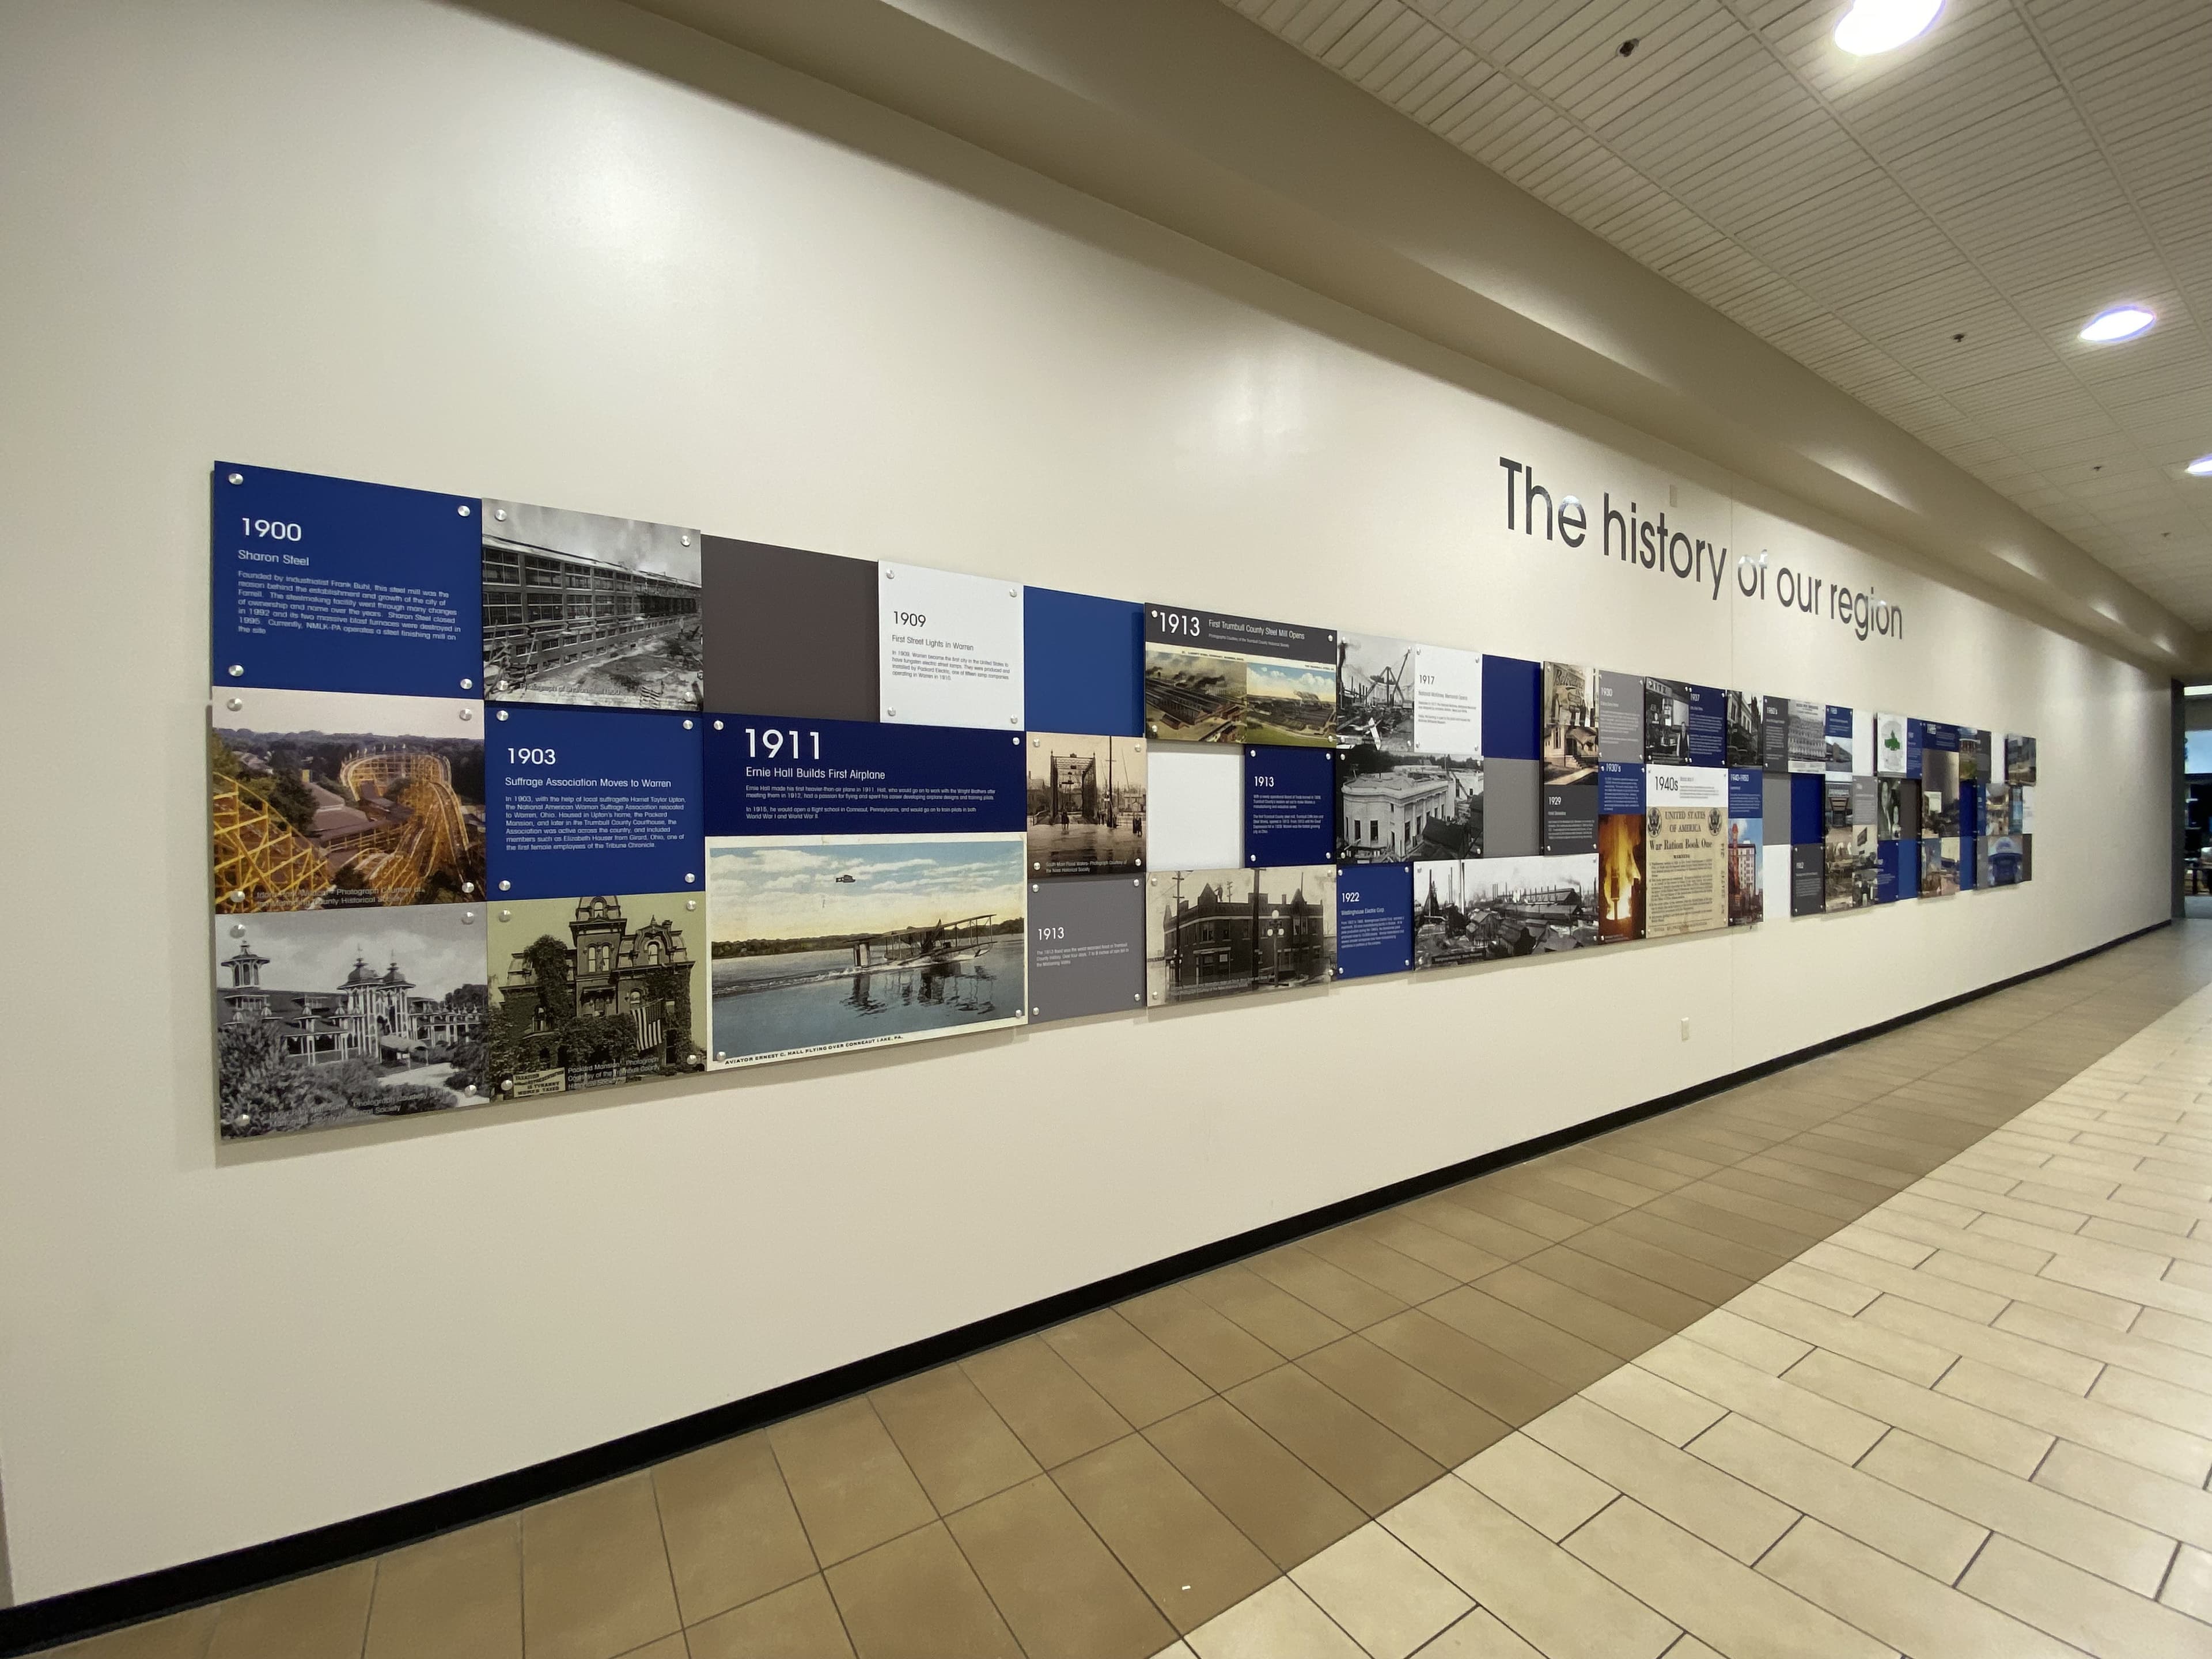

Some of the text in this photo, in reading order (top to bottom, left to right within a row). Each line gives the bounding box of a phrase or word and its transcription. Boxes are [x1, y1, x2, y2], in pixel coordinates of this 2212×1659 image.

[242, 517, 302, 541] 1900
[1499, 456, 1903, 641] The history of our region
[237, 550, 309, 566] Sharon Steel
[238, 570, 271, 581] Founded
[274, 573, 284, 584] by
[389, 585, 405, 593] steel
[407, 587, 421, 595] mill
[438, 589, 449, 597] the
[267, 582, 293, 592] behind
[295, 585, 307, 593] the
[378, 593, 402, 601] growth
[412, 596, 423, 604] the
[425, 597, 437, 607] city
[893, 611, 926, 627] 1909
[1160, 612, 1200, 637] 1913
[1209, 619, 1305, 640] First Trumbull County Steel Mill Opens
[892, 635, 906, 643] First
[907, 636, 924, 645] Street
[926, 638, 944, 649] Lights
[953, 642, 974, 651] Warren
[1419, 675, 1435, 685] 1917
[1601, 687, 1613, 697] 1930
[745, 728, 820, 760] 1911
[507, 748, 556, 765] 1903
[746, 767, 885, 781] Ernie Hall Builds First Airplane
[1606, 763, 1621, 773] 1930's
[505, 777, 672, 788] Suffrage Association Moves to Warren
[1254, 776, 1274, 787] 1913
[1654, 776, 1679, 791] 1940s
[560, 796, 574, 804] help
[1548, 796, 1562, 805] 1929
[1665, 811, 1706, 820] UNITED STATES
[1669, 824, 1702, 832] OF AMERICA
[1649, 838, 1713, 850] War Ration Book One
[336, 888, 379, 896] Photograph
[1342, 892, 1360, 903] 1922
[1037, 927, 1065, 941] 1913
[725, 1056, 753, 1065] AVIATOR
[845, 1039, 875, 1047] CONNEAUT
[567, 1066, 593, 1074] Packard
[626, 1057, 659, 1066] Photograph
